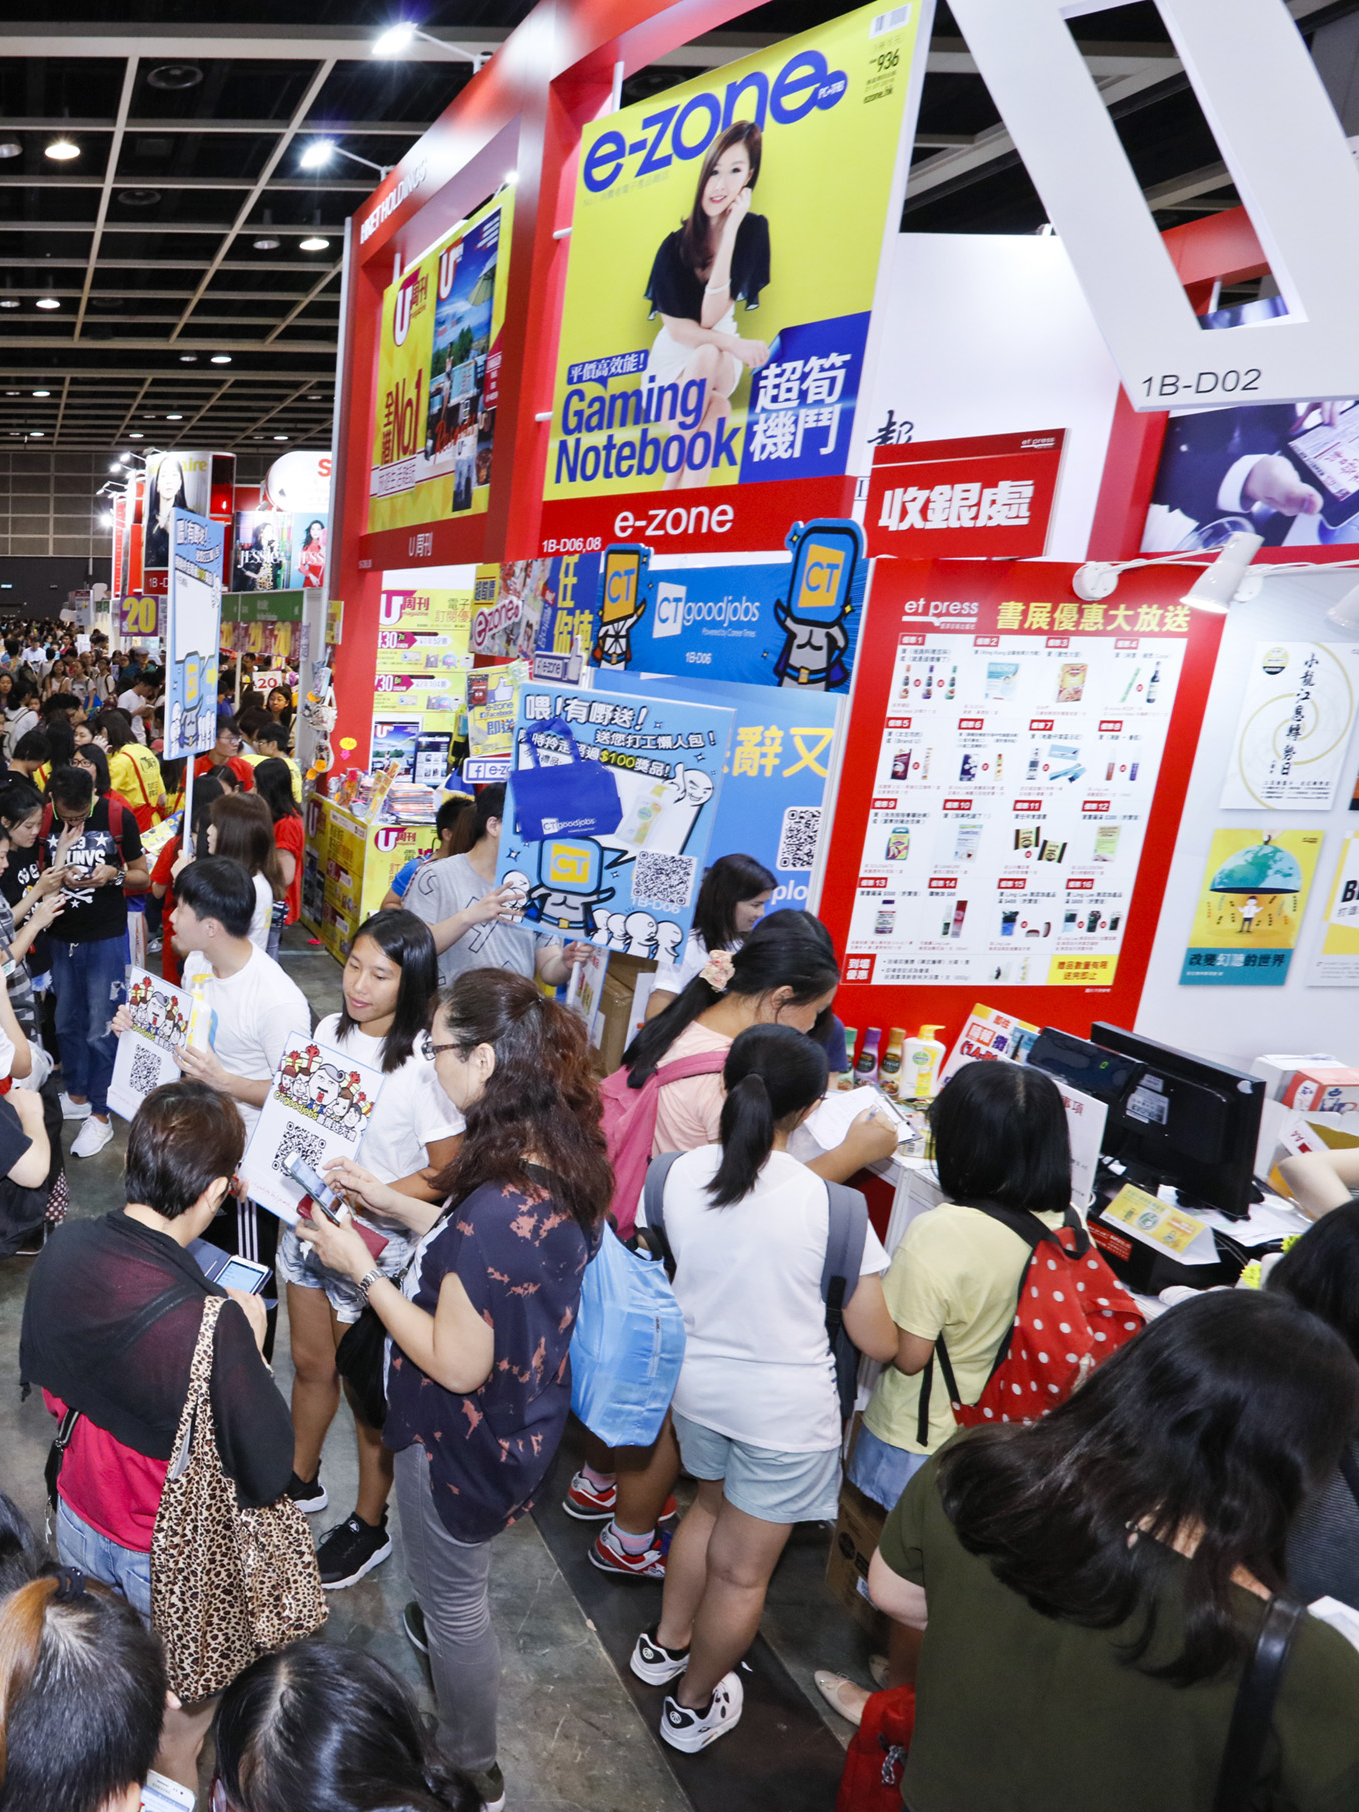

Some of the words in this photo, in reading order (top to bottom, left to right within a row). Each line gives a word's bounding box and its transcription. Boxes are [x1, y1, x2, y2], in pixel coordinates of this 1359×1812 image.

[1141, 368, 1262, 398] 1B-D02
[561, 374, 707, 437] Gaming
[554, 417, 740, 485] Notebook
[613, 502, 735, 538] e-zone
[877, 480, 1035, 532] 收銀處
[298, 549, 326, 567] JESS
[541, 537, 602, 553] 1B-D06,08
[607, 567, 637, 604] CT
[805, 560, 840, 595] CT
[904, 597, 926, 614] et
[928, 601, 980, 618] press
[996, 600, 1191, 633] 書展優惠大放送
[257, 677, 278, 689] 20
[552, 851, 590, 876] CT
[773, 879, 808, 903] plo
[1340, 879, 1359, 903] B
